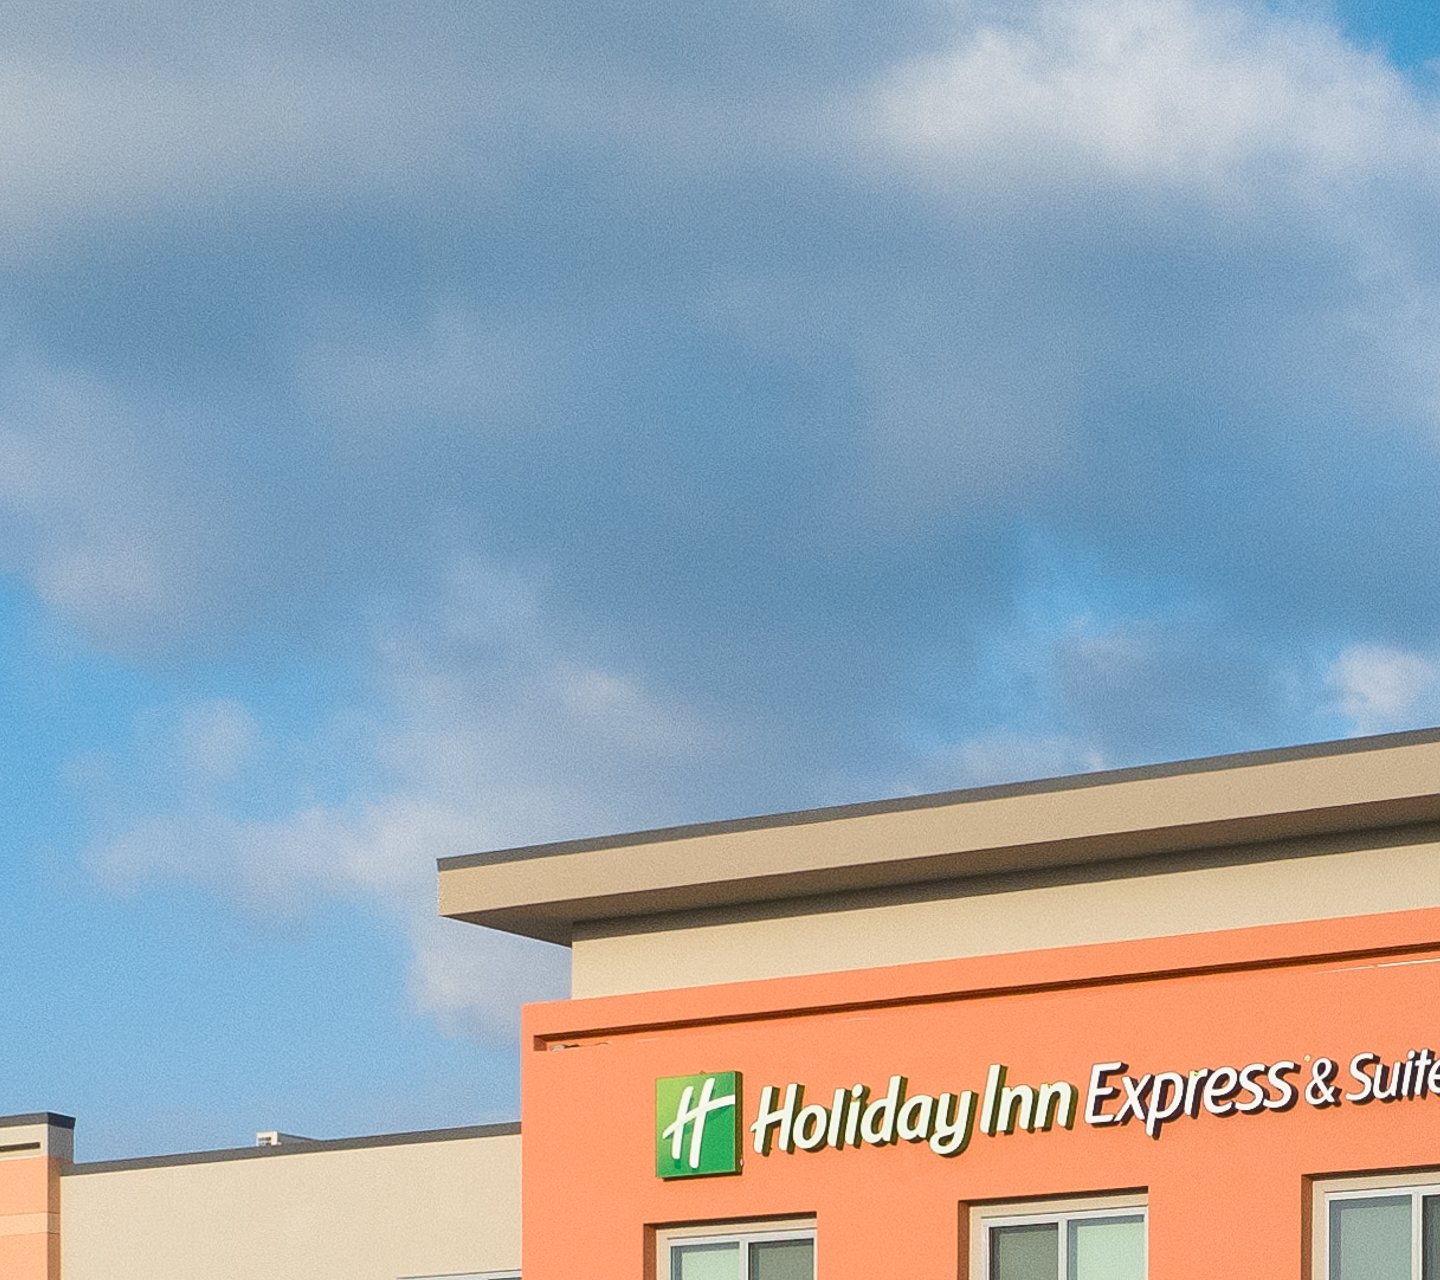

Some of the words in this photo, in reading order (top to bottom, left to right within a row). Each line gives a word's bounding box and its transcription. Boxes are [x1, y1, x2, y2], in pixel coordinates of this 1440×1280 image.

[750, 1074, 974, 1156] Holiday
[979, 1063, 1071, 1135] Inn
[1083, 1060, 1296, 1138] Express
[1304, 1057, 1338, 1105] &
